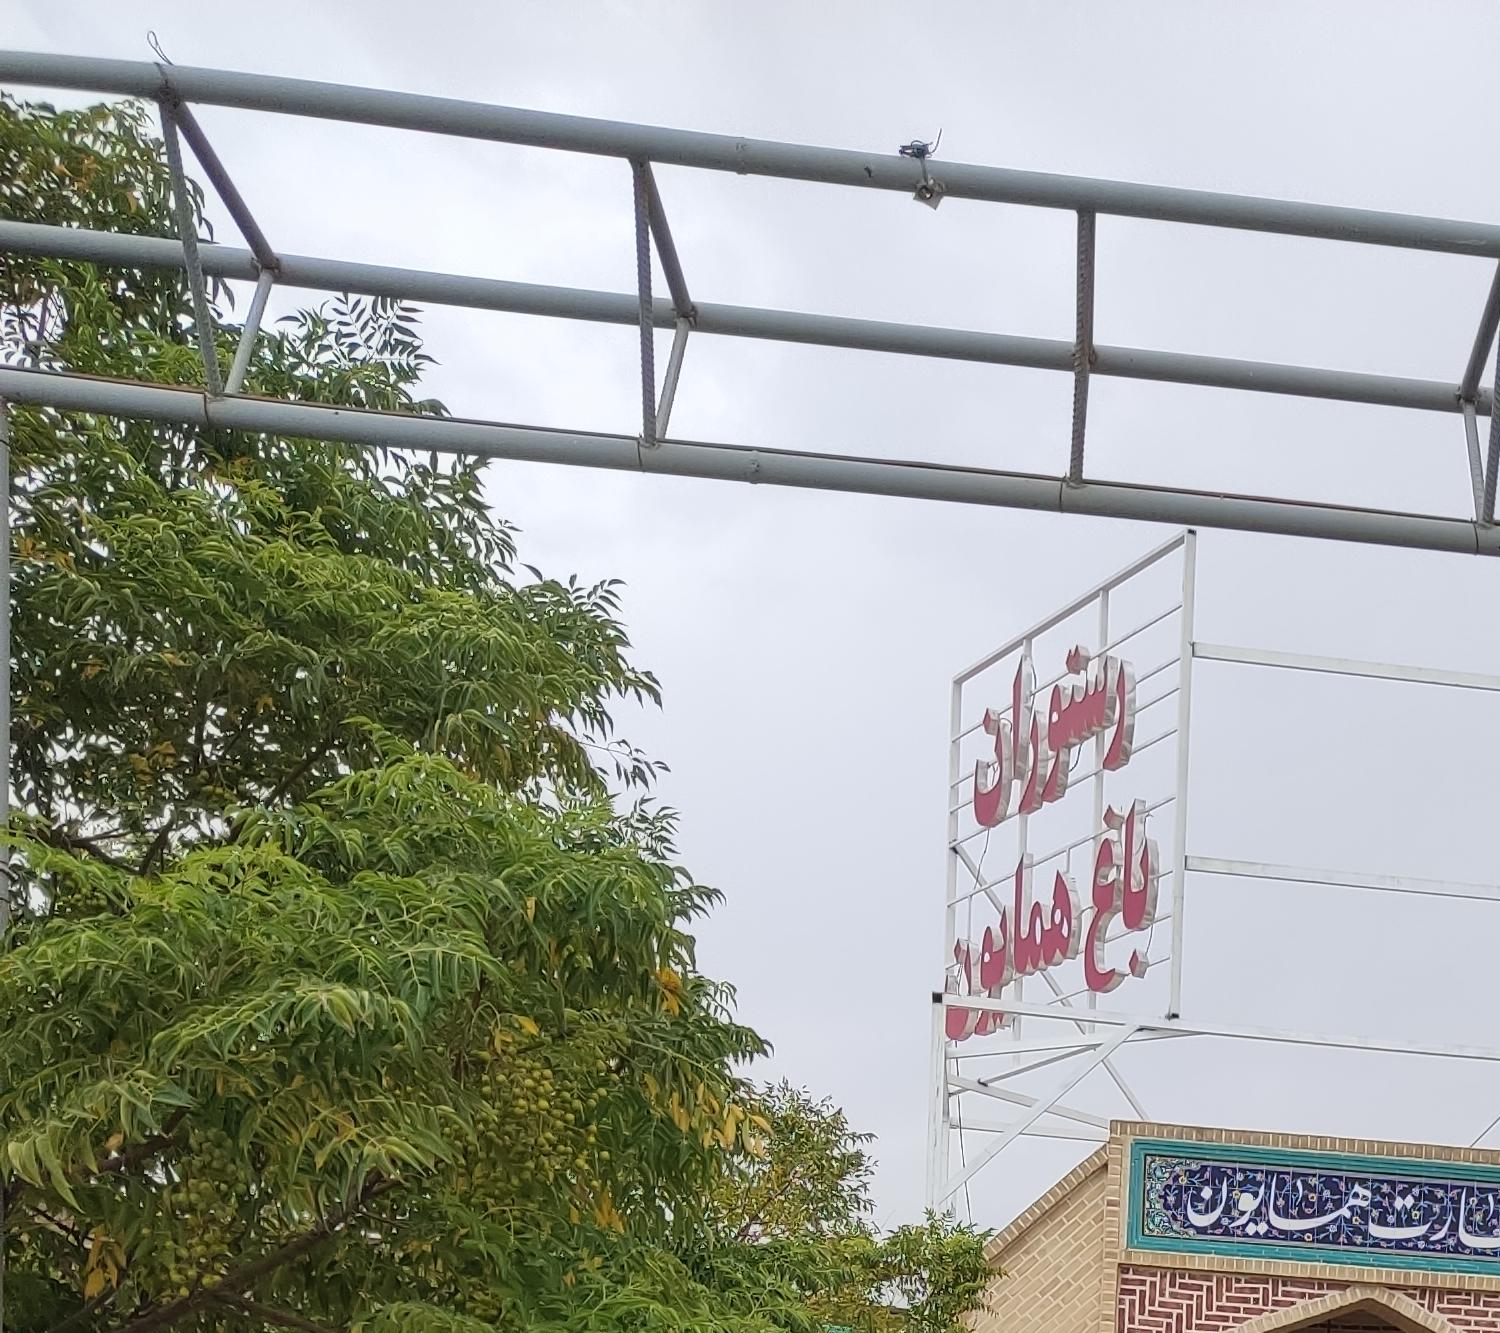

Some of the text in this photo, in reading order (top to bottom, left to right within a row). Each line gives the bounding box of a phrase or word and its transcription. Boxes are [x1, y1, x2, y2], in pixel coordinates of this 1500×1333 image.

[974, 644, 1137, 827] رستوران
[945, 799, 1160, 1041] باغ همایون
[1186, 1173, 1373, 1237] همایون
